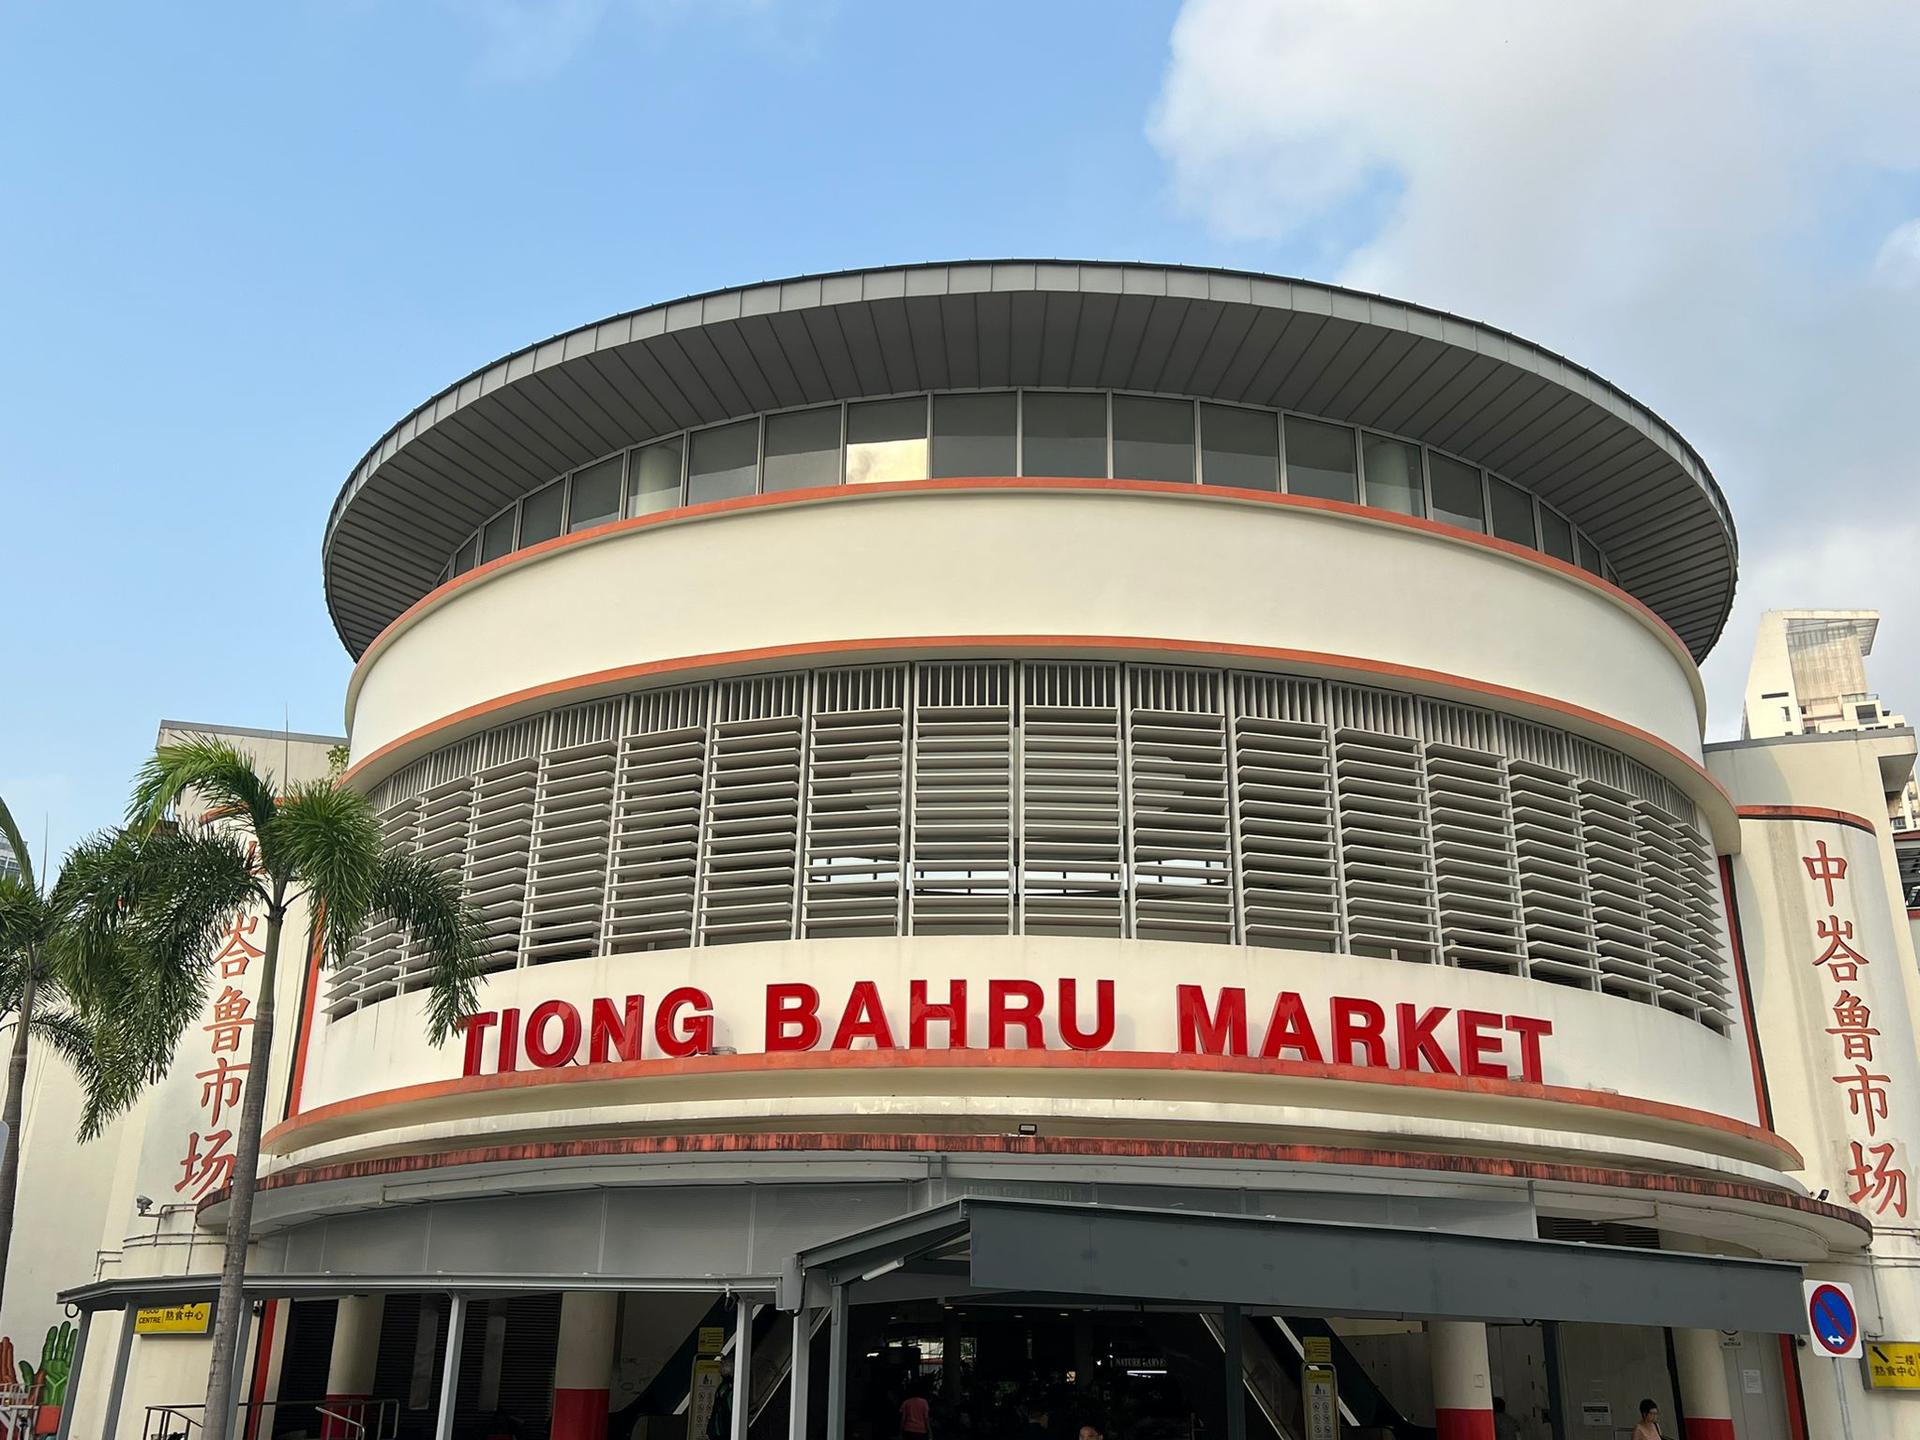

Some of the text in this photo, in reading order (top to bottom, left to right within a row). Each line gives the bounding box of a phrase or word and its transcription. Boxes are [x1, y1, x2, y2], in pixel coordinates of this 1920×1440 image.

[457, 978, 1553, 1083] TIONG BAHRU MARKET
[1802, 840, 1907, 1218] 中峇鲁市场
[138, 1316, 161, 1324] CENTRE
